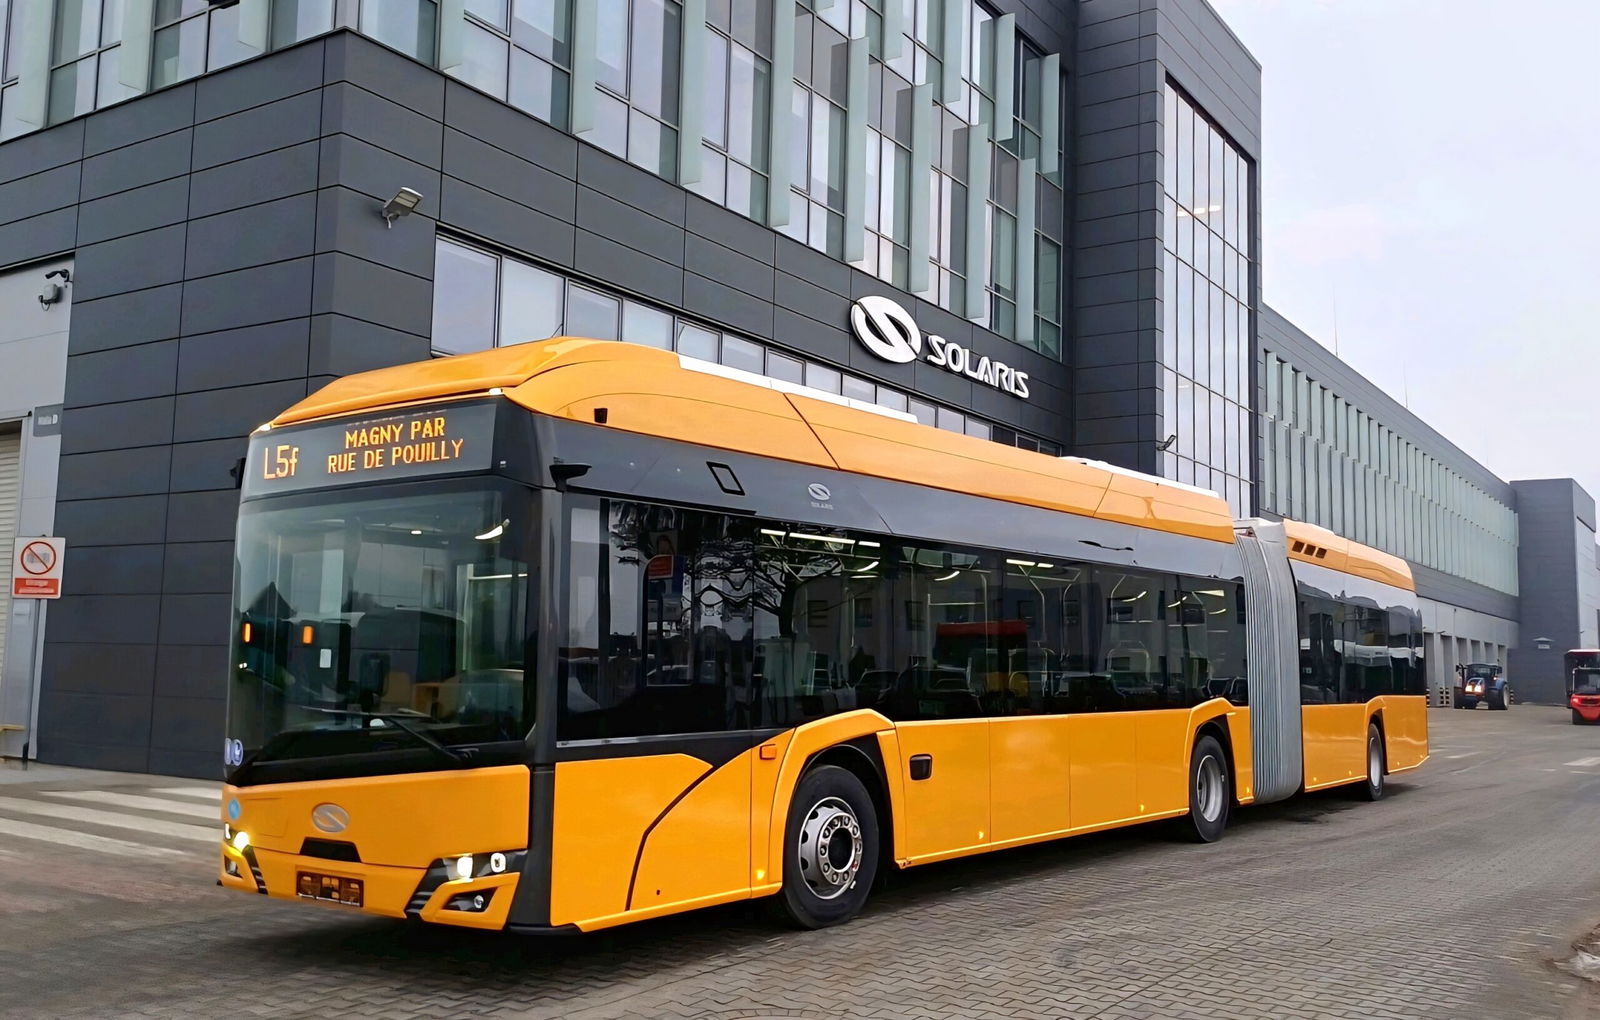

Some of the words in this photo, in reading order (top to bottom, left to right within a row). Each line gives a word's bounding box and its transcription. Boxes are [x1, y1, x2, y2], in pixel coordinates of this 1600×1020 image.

[927, 335, 1030, 398] SOLARIS
[345, 424, 403, 449] MAGNY
[411, 417, 445, 440] PAR
[264, 445, 299, 480] L5f
[328, 453, 357, 473] RUE
[364, 449, 385, 469] DE
[392, 438, 463, 466] POUILLY
